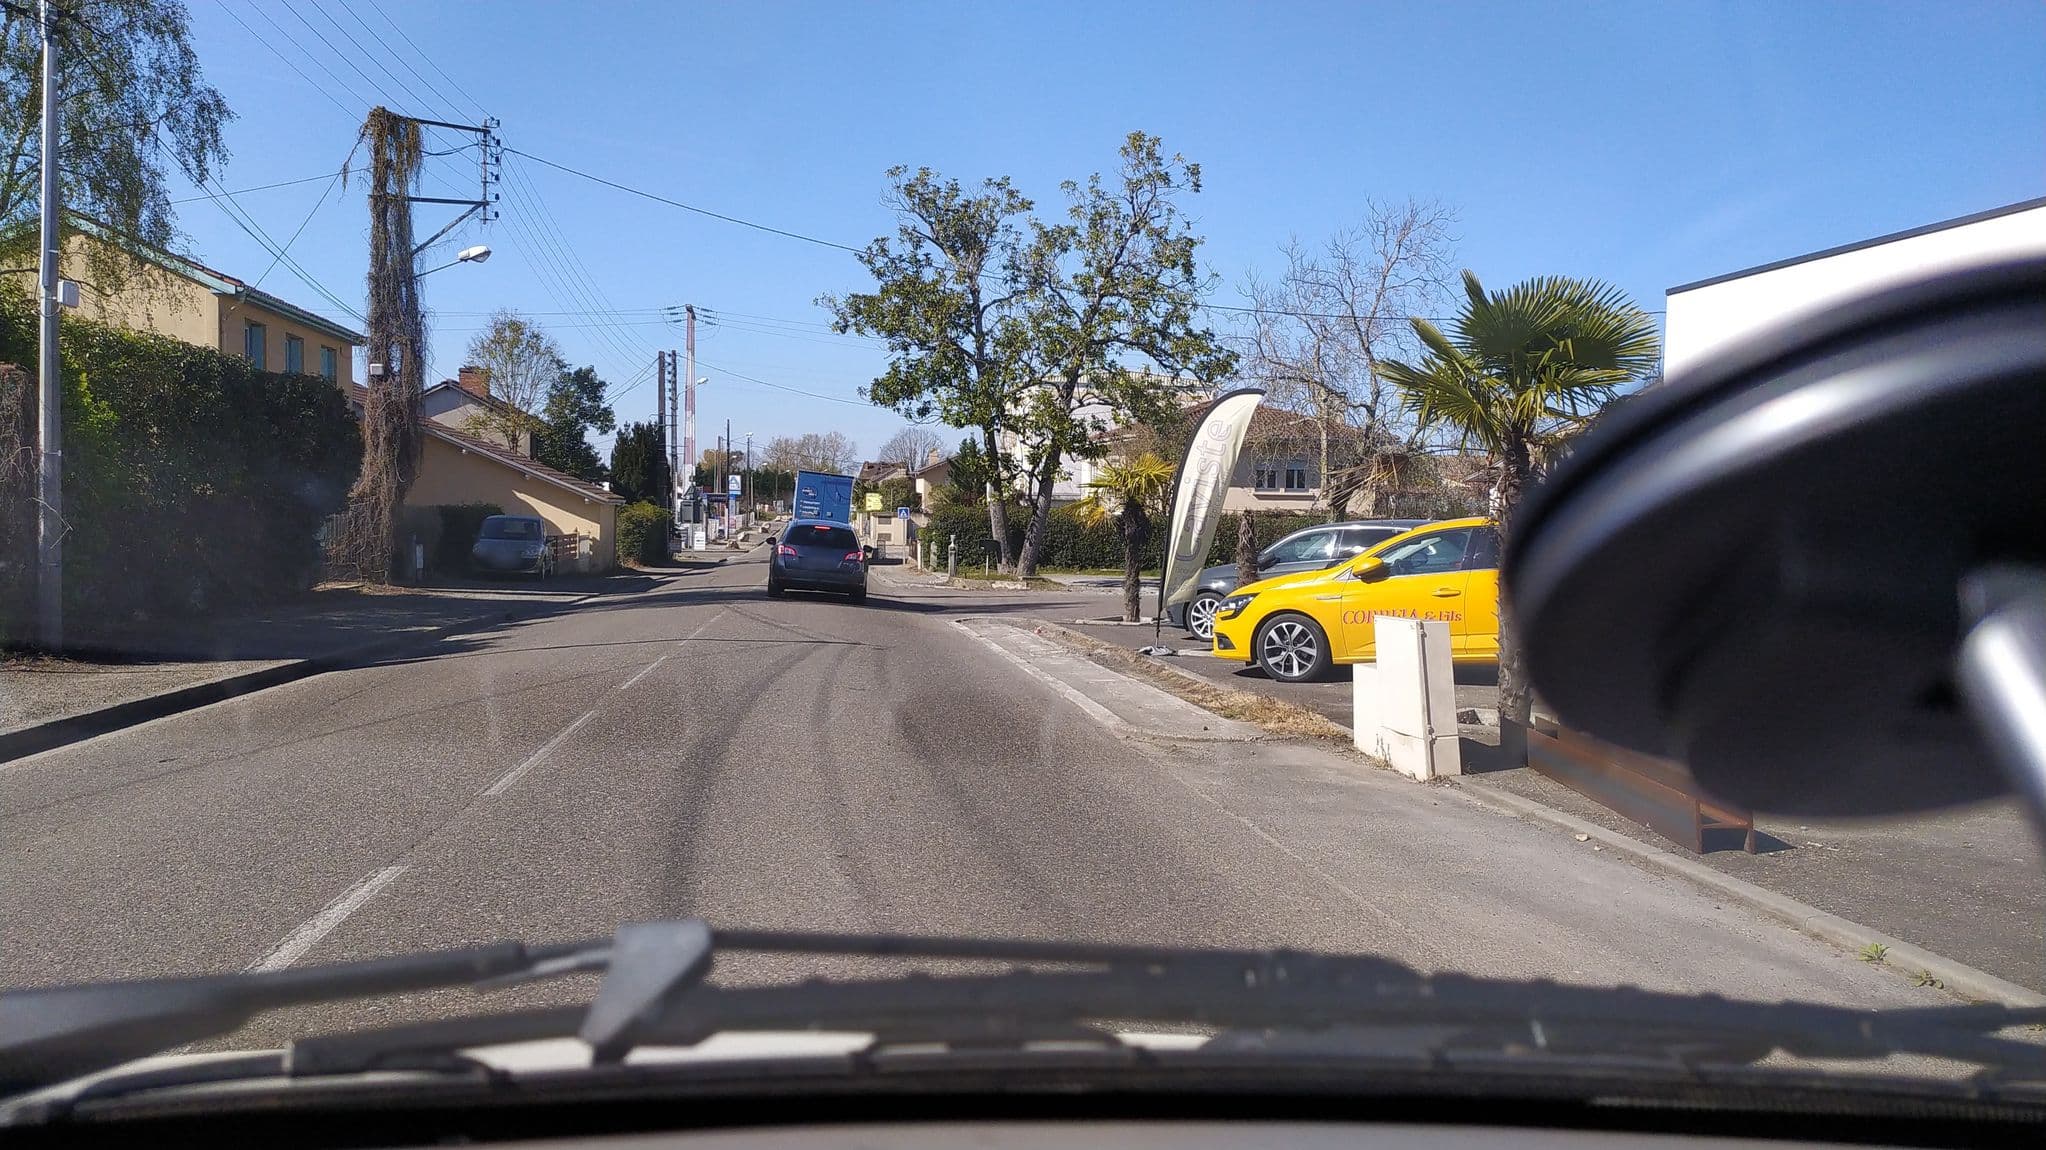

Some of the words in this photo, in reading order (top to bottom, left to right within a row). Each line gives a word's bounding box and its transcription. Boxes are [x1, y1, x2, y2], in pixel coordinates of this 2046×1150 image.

[1175, 418, 1233, 562] Caviste
[1425, 611, 1436, 620] &
[1439, 610, 1462, 621] Fils
